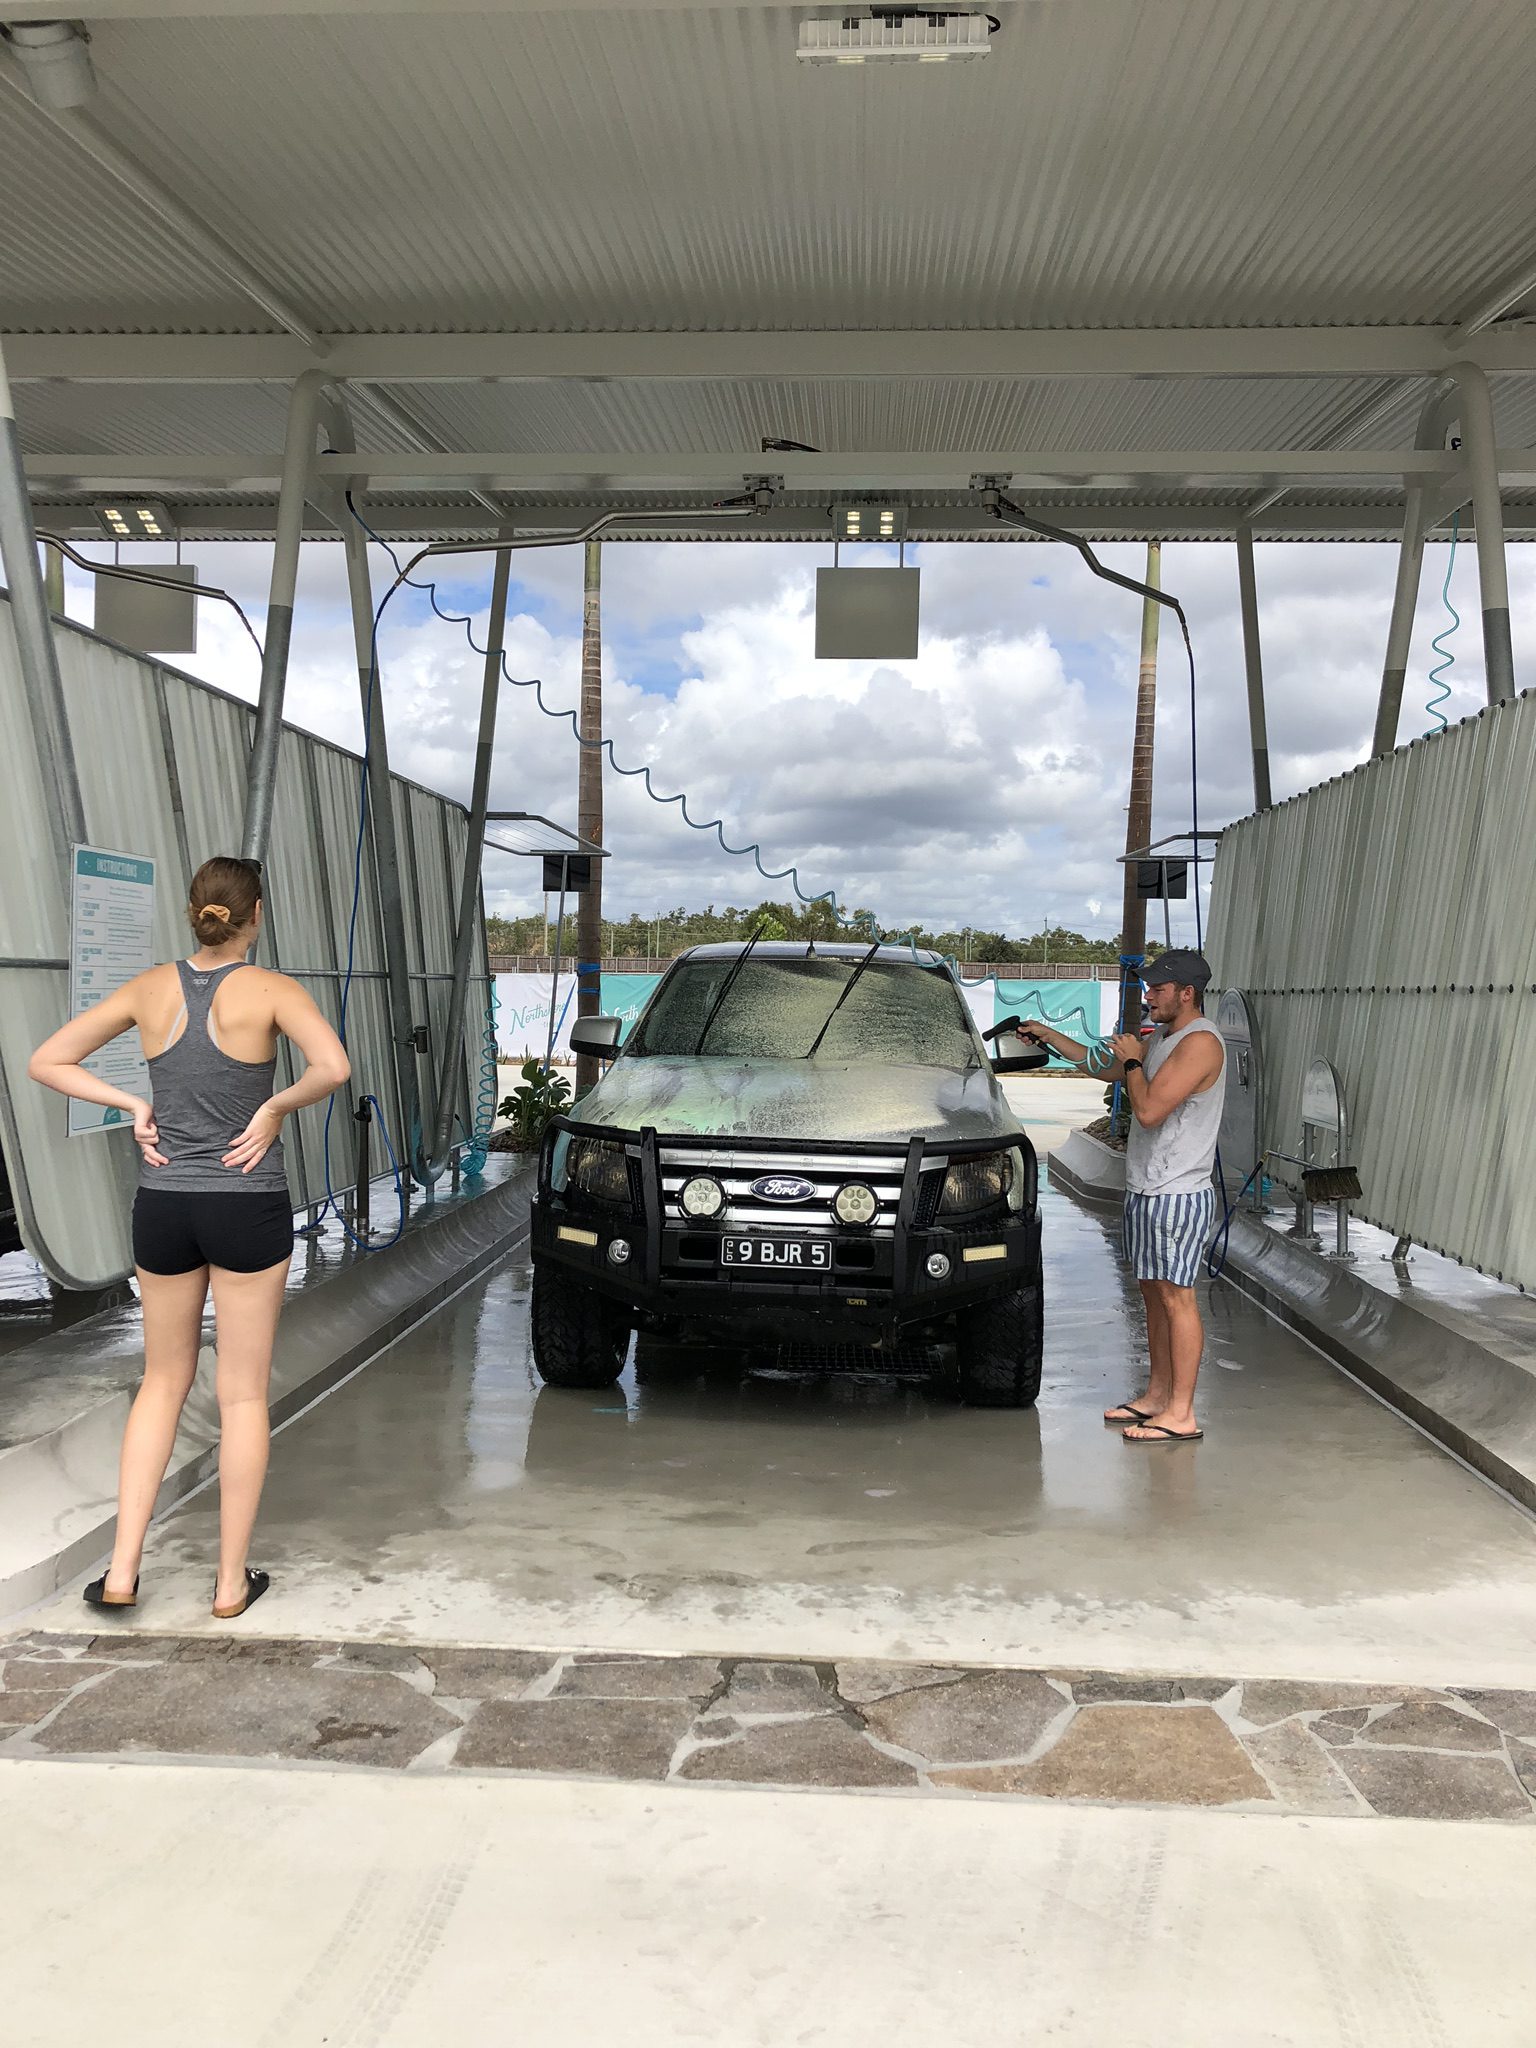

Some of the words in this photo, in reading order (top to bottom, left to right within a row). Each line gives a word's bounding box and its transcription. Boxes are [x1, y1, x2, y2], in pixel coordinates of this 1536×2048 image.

[96, 857, 138, 878] INSTRUCTIONS
[509, 1003, 566, 1035] Northshre
[764, 1179, 801, 1196] Ford
[726, 1240, 734, 1261] QLD
[738, 1241, 753, 1261] 9
[760, 1242, 803, 1264] BJR
[811, 1244, 826, 1265] 5
